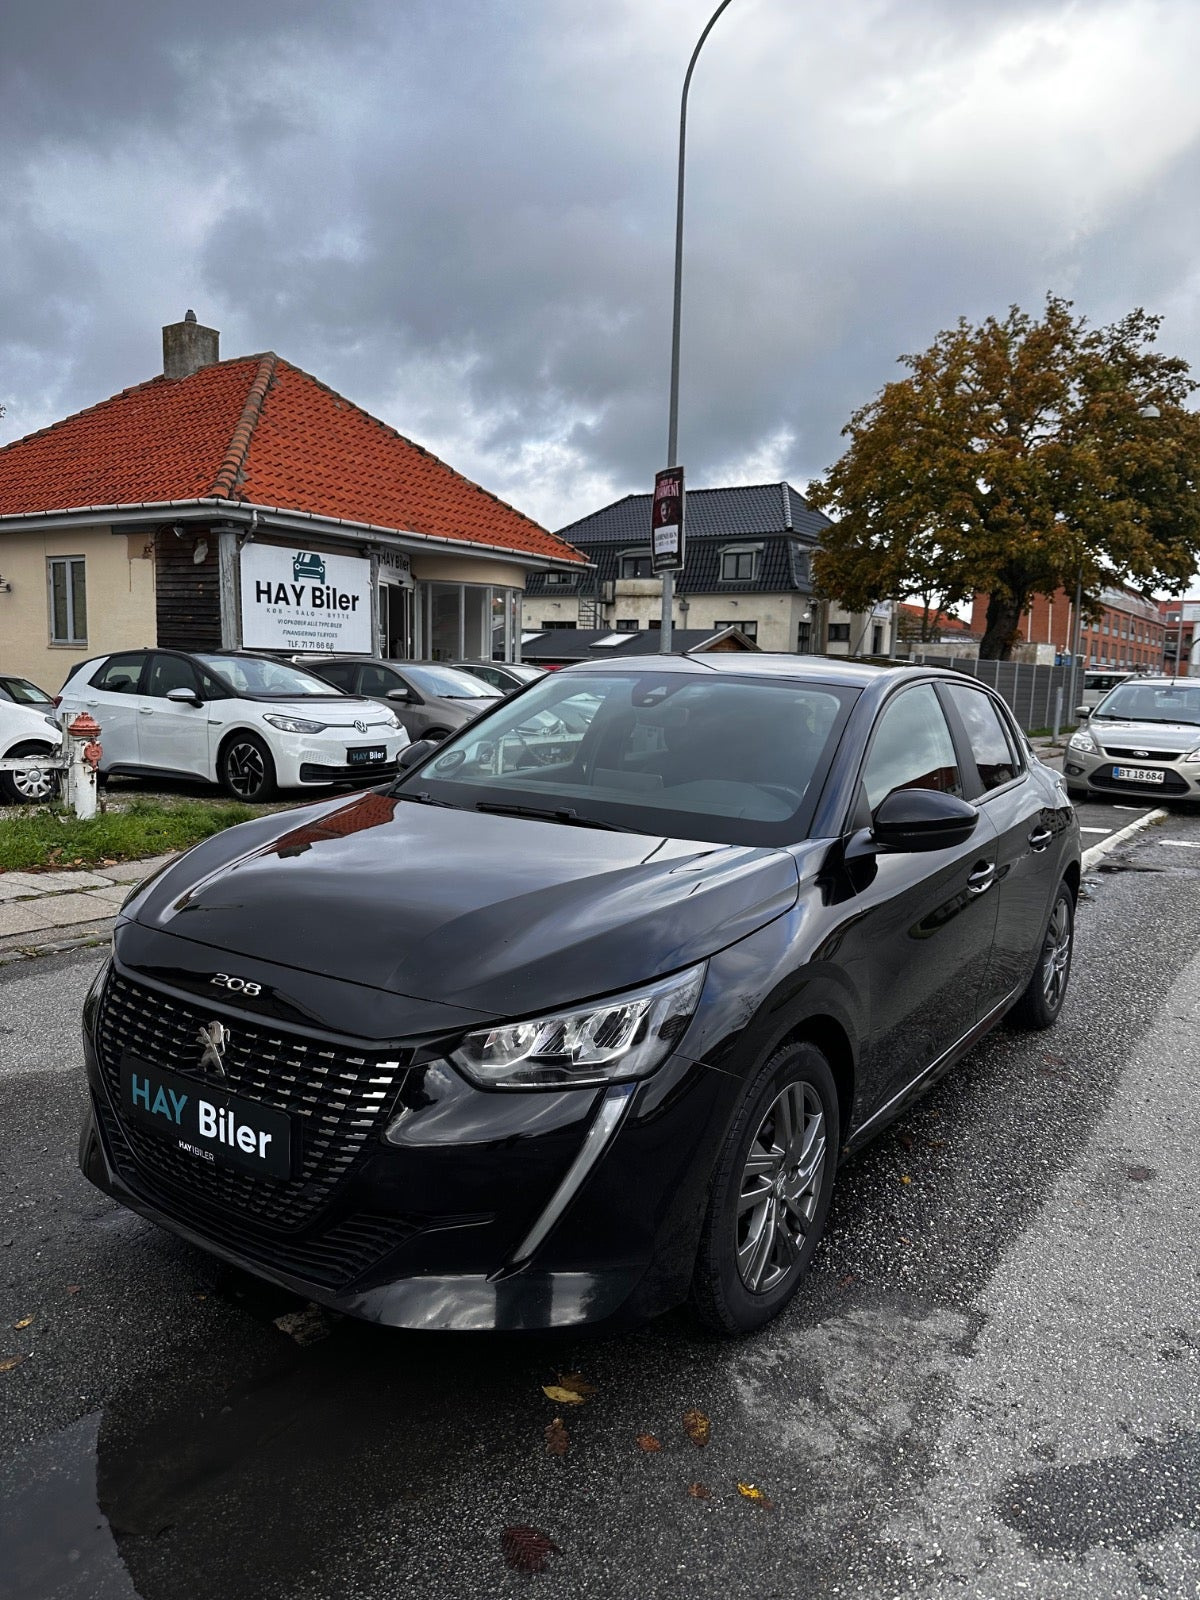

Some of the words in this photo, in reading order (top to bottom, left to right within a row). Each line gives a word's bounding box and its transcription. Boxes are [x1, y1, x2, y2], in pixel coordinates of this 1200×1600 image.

[255, 580, 306, 606] HAY
[311, 585, 360, 611] Biler
[301, 640, 308, 648] 71
[309, 641, 315, 649] 71
[352, 752, 368, 760] HAY
[369, 751, 384, 760] Biler
[1119, 769, 1131, 777] BT
[1133, 770, 1145, 779] 18
[1145, 771, 1163, 781] 684
[210, 973, 262, 997] 208
[131, 1073, 188, 1125] HAY
[198, 1099, 272, 1159] Biler
